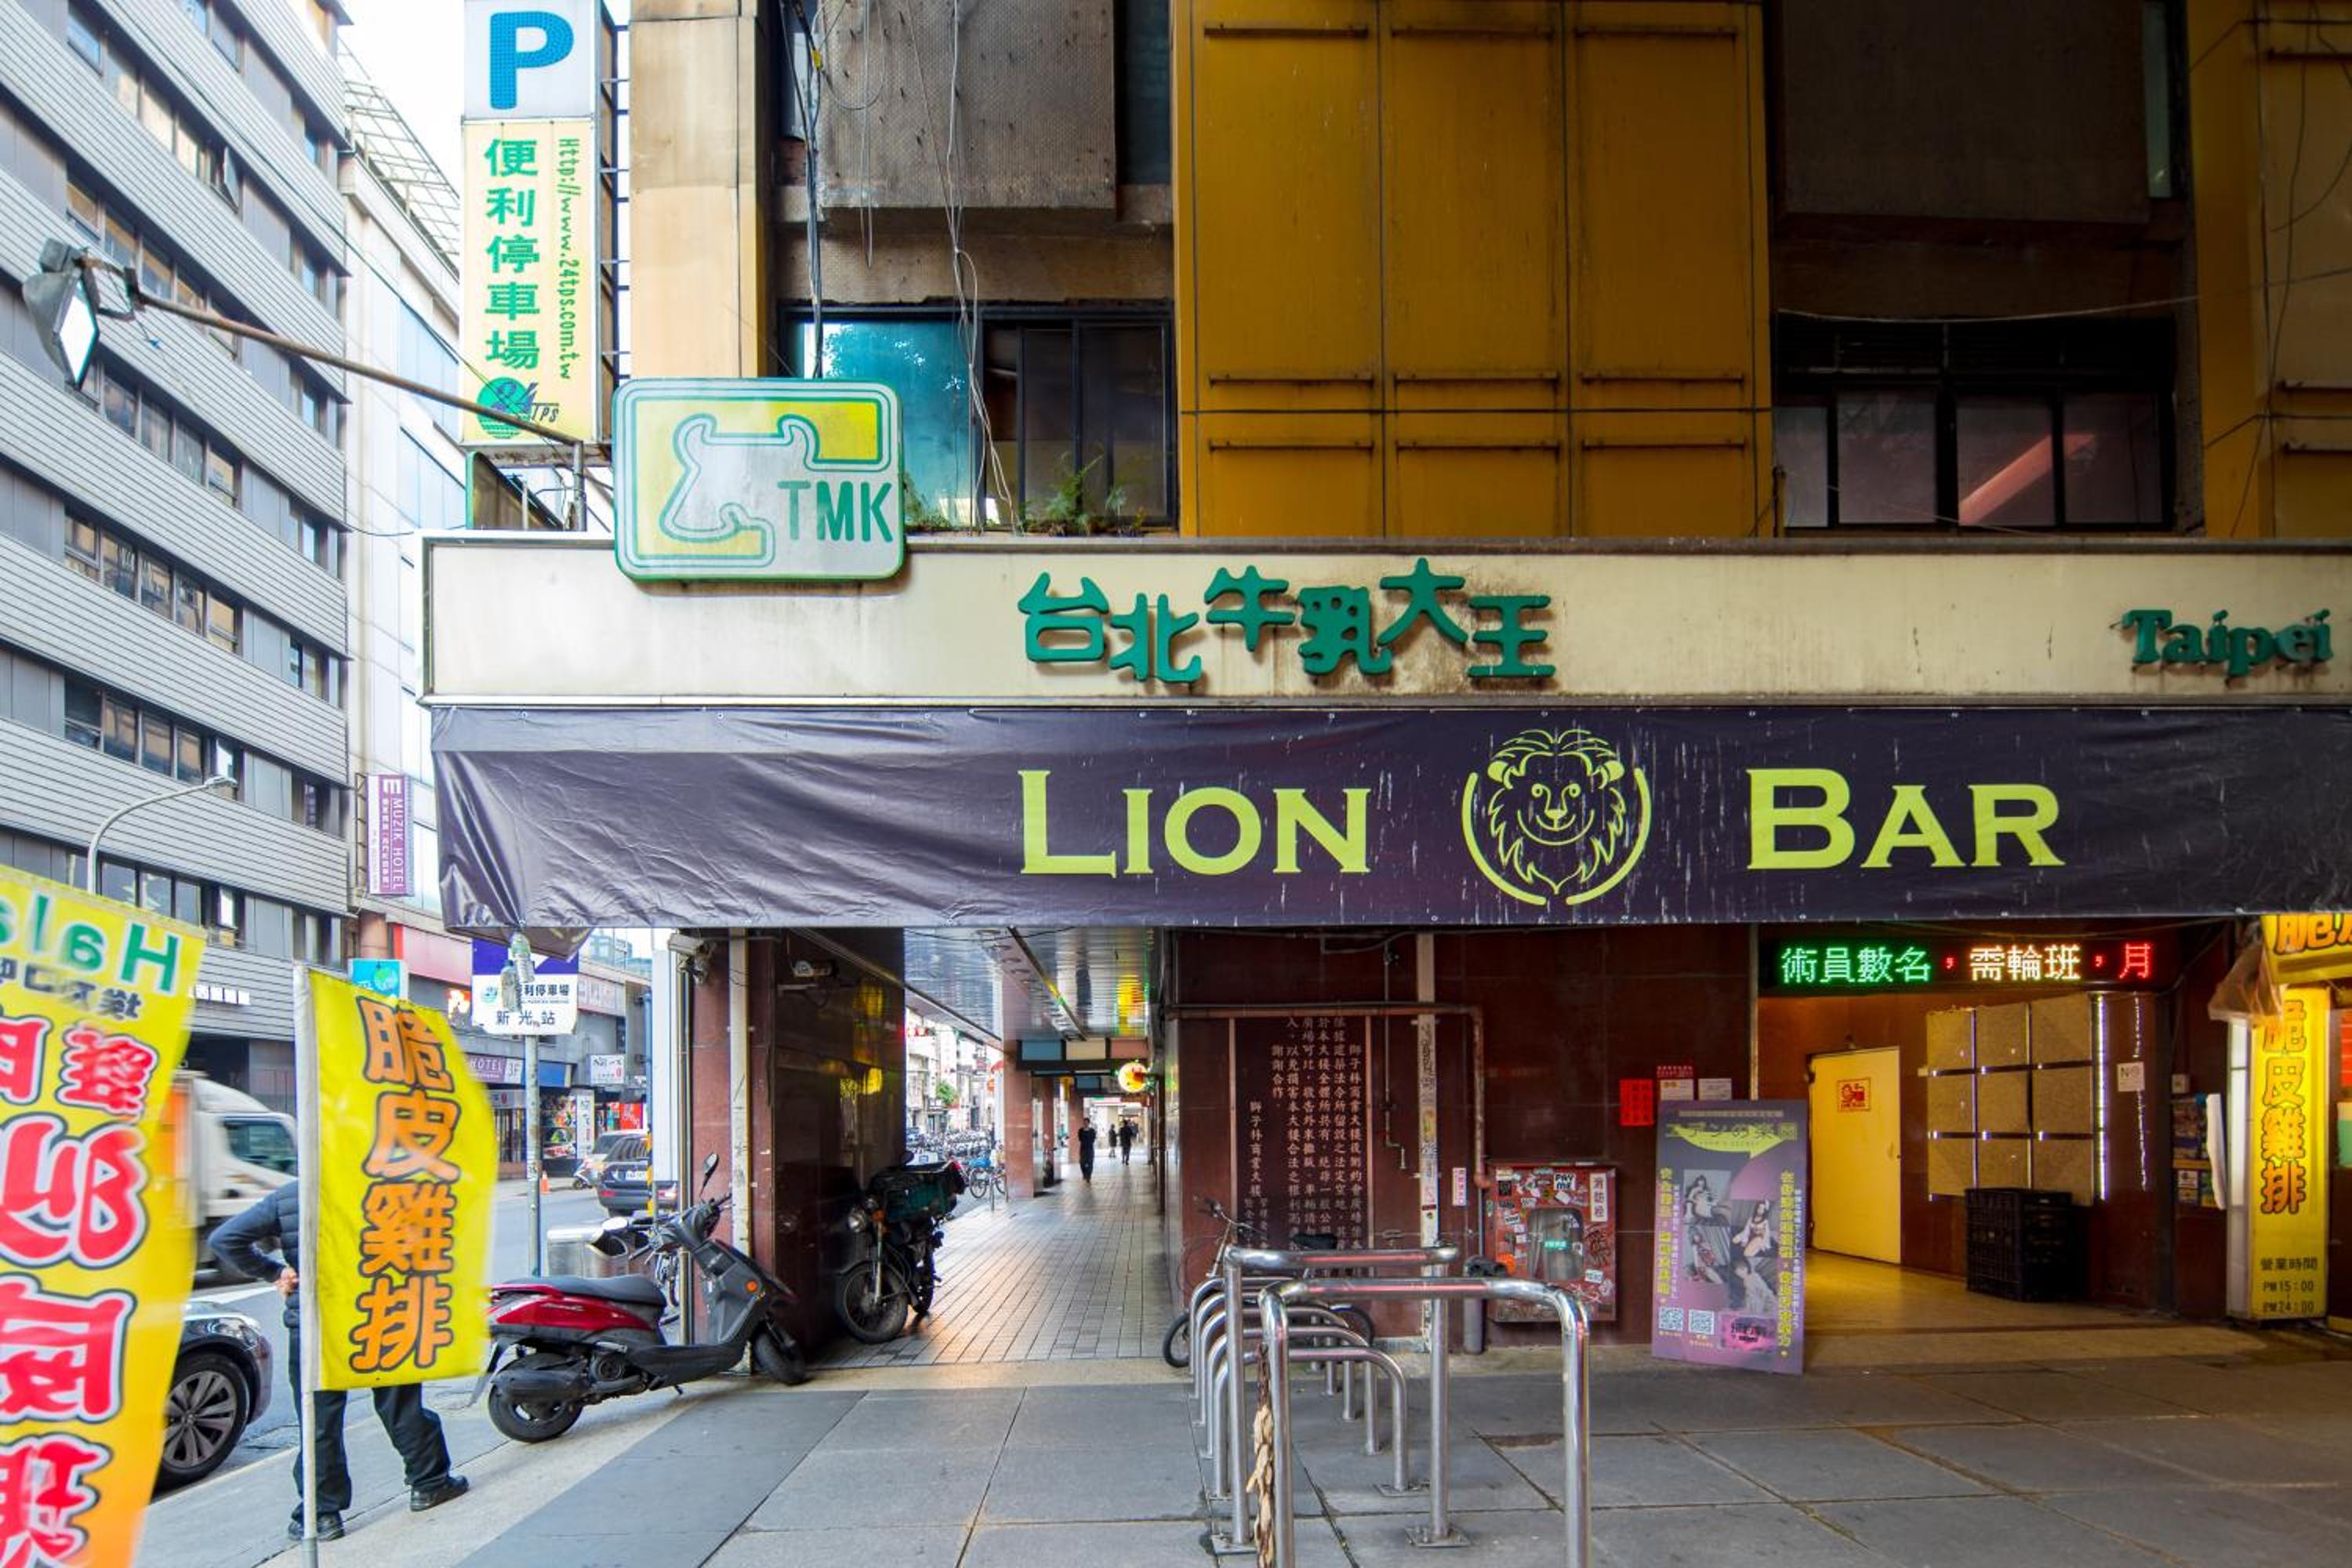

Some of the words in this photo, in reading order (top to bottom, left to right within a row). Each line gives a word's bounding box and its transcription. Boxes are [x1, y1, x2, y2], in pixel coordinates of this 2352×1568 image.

[490, 12, 575, 109] P
[485, 138, 540, 371] 便利停車場
[557, 138, 582, 381] Http://www.24tps.com.tw
[778, 480, 894, 544] TMK
[1018, 557, 1558, 684] 台北牛乳大王
[2122, 609, 2335, 676] Taipei
[393, 798, 404, 840] MUZIK
[393, 849, 405, 891] HOTEL
[496, 1010, 557, 1026] 新光站
[349, 996, 463, 1374] 脆皮雞排
